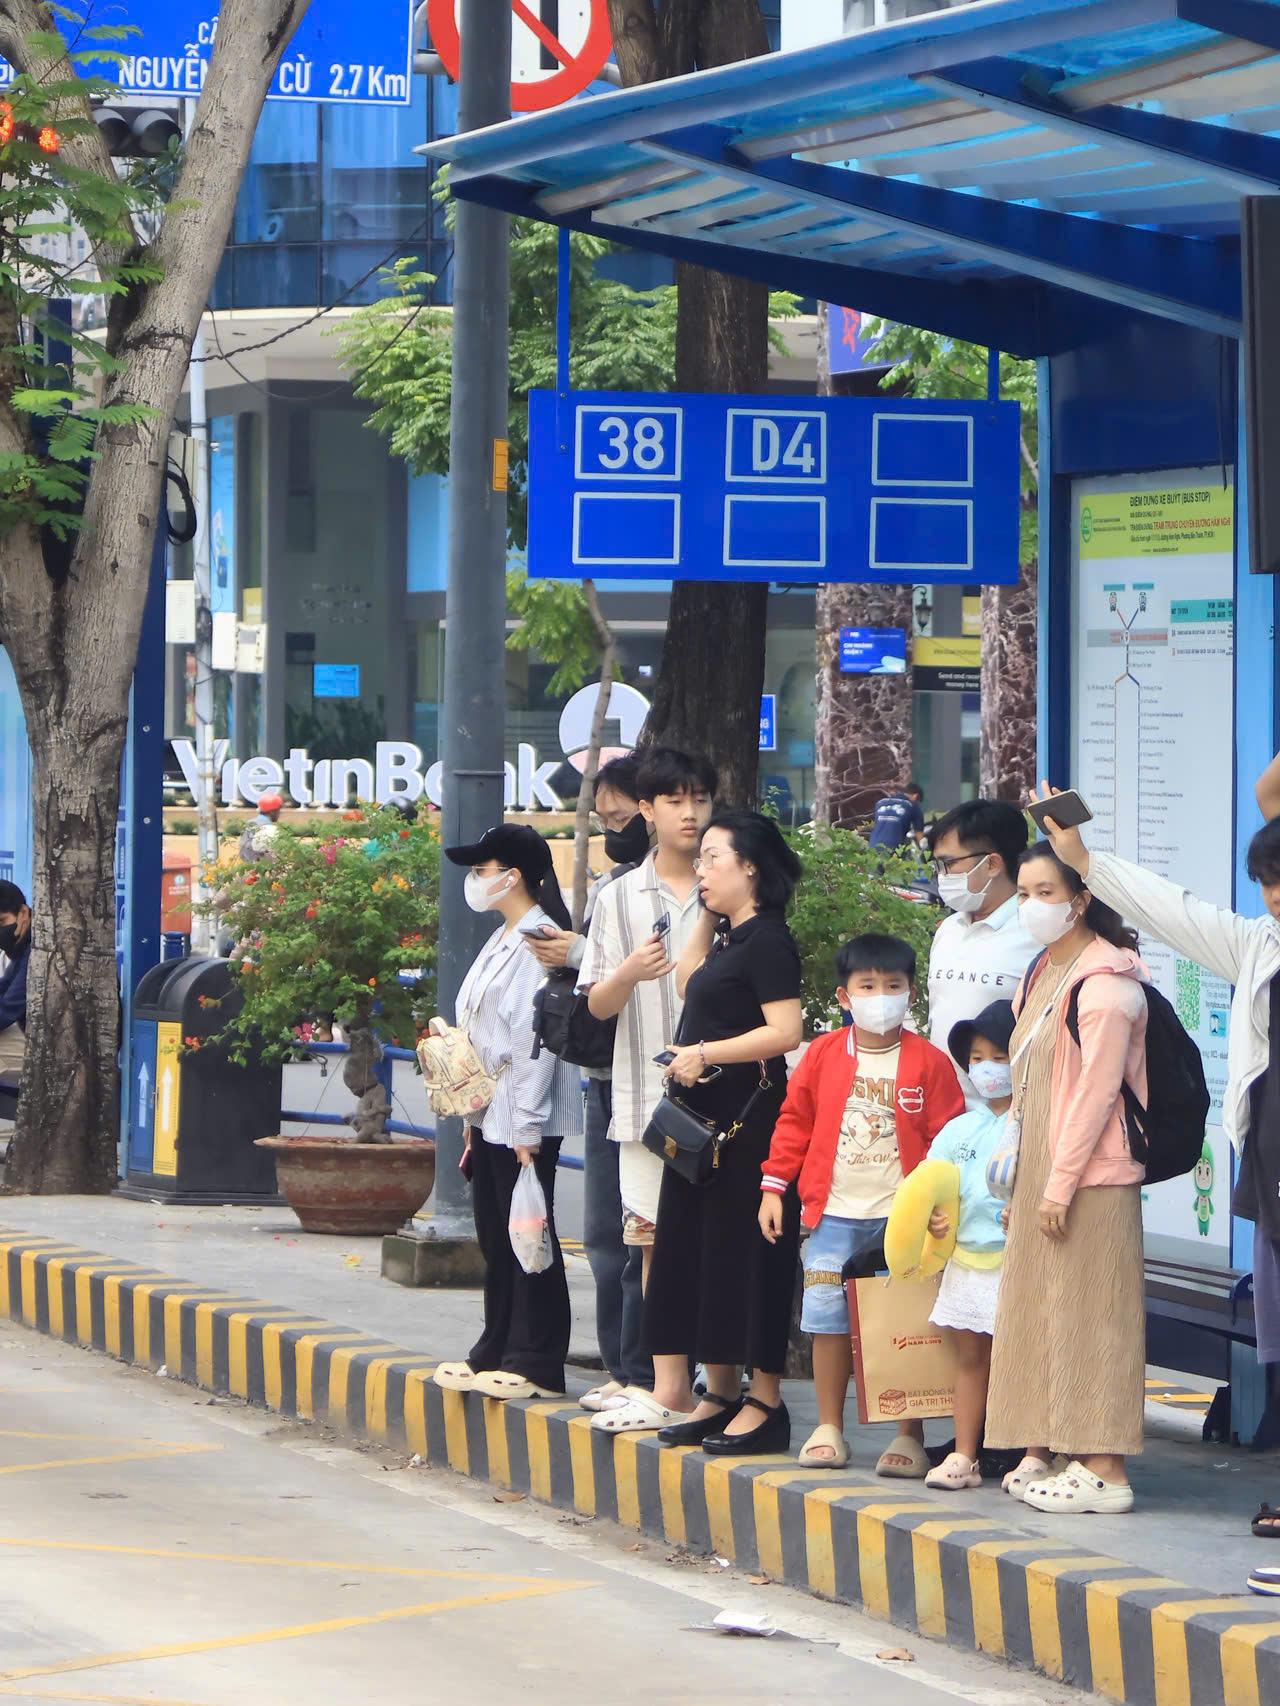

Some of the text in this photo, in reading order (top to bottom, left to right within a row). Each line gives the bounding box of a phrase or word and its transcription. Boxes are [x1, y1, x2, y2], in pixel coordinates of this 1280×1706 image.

[329, 63, 362, 97] 2,7
[368, 65, 407, 96] Km
[598, 416, 664, 470] 38
[752, 418, 815, 473] D4
[929, 968, 1005, 986] EGANCE
